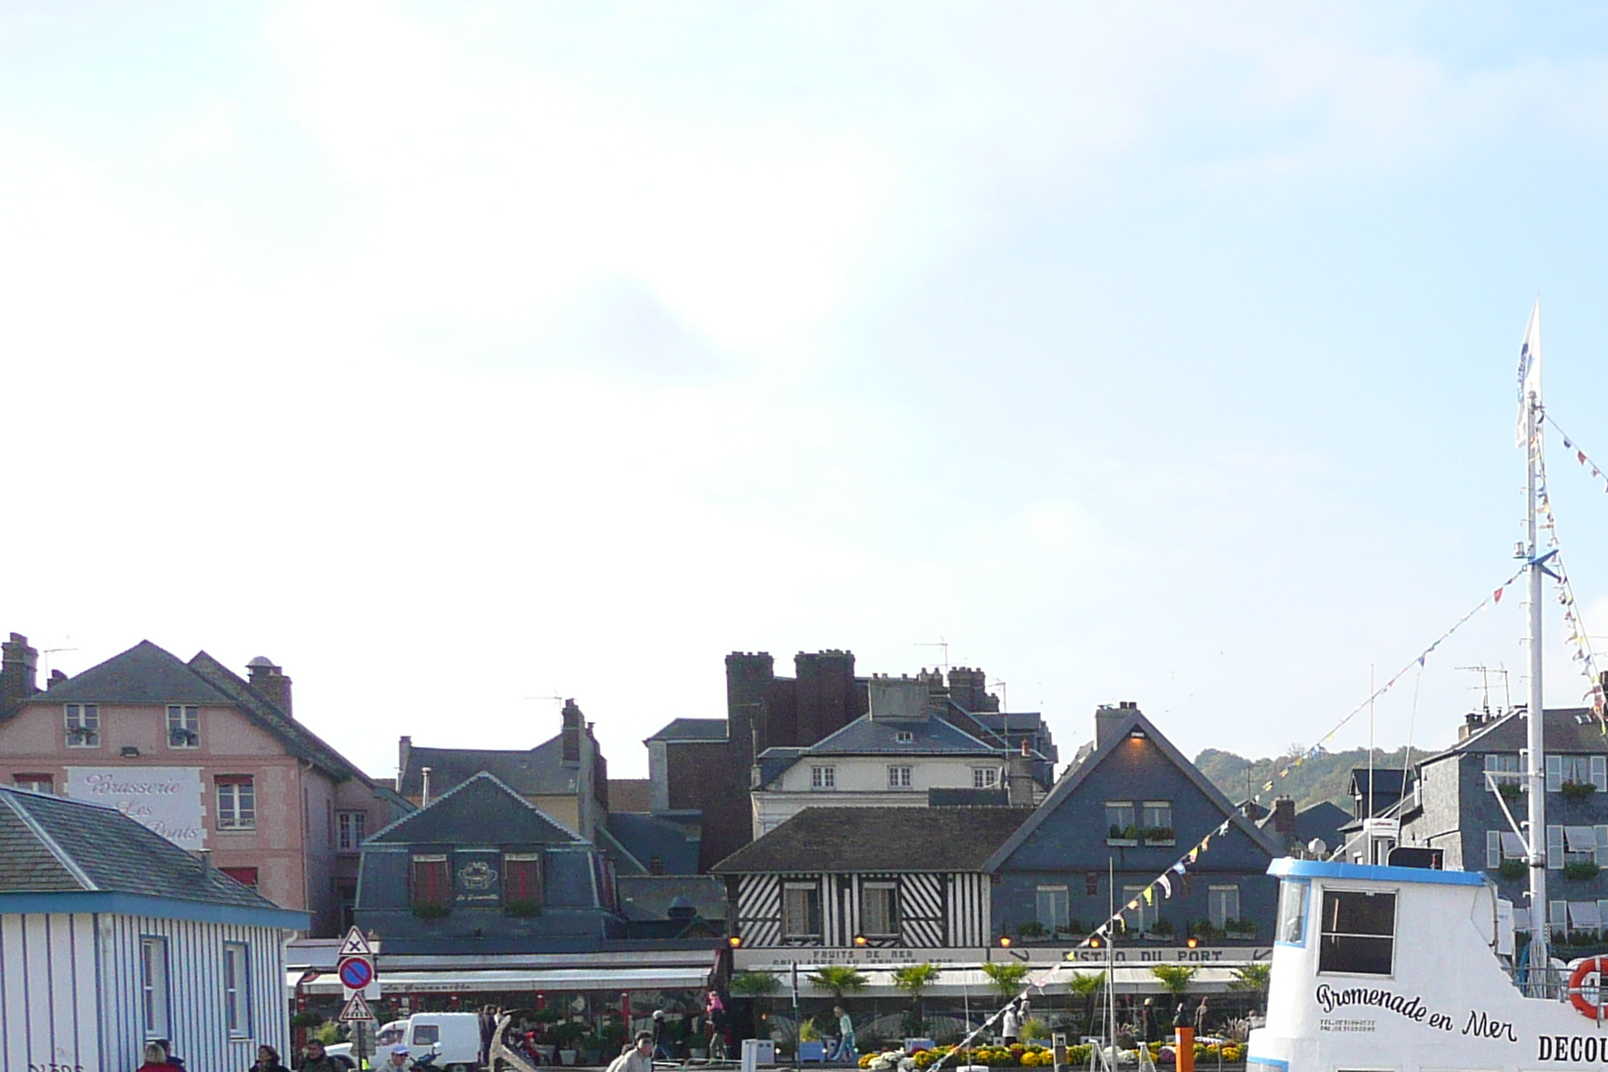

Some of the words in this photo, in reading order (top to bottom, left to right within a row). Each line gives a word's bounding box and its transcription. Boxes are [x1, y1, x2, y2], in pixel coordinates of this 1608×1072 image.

[86, 774, 180, 795] Brasserie
[116, 799, 153, 818] Les
[813, 950, 854, 959] FRUITS
[866, 950, 880, 959] DE
[891, 950, 913, 959] MER
[1141, 950, 1162, 962] DU
[1178, 950, 1223, 962] PORT
[1316, 984, 1428, 1022] Promenade
[1428, 1012, 1454, 1032] en
[1462, 1010, 1518, 1042] Mer
